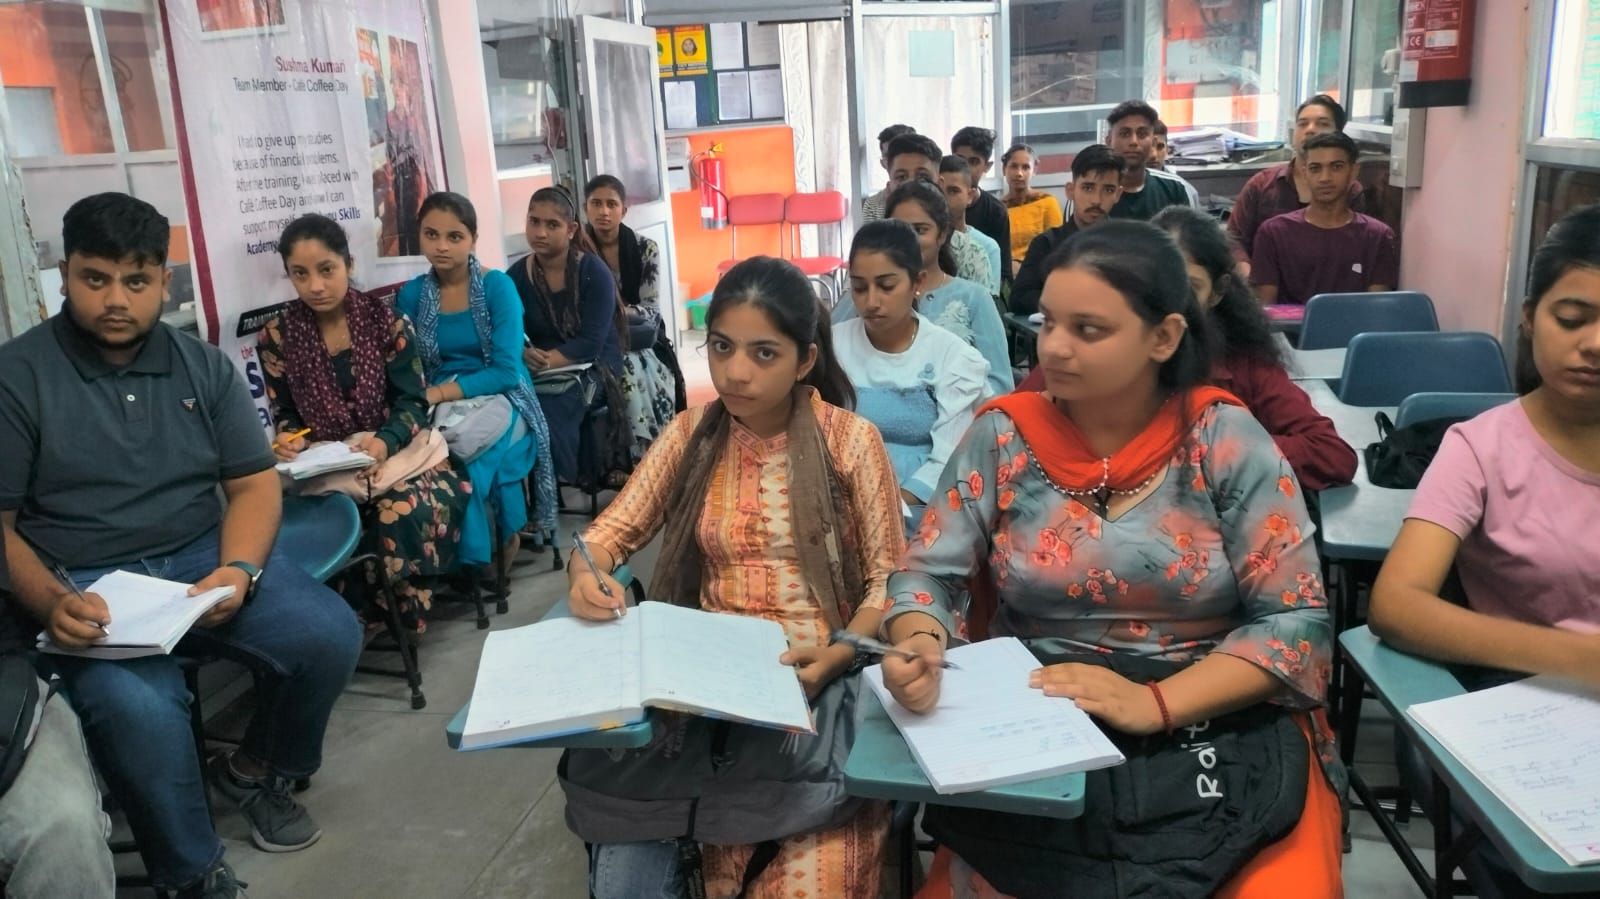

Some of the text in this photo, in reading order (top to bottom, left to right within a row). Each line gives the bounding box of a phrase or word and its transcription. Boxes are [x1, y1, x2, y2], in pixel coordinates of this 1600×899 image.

[264, 134, 283, 151] give
[284, 135, 297, 150] up
[260, 154, 268, 169] of
[279, 195, 297, 211] Day
[330, 192, 345, 203] can
[338, 206, 361, 221] Skills
